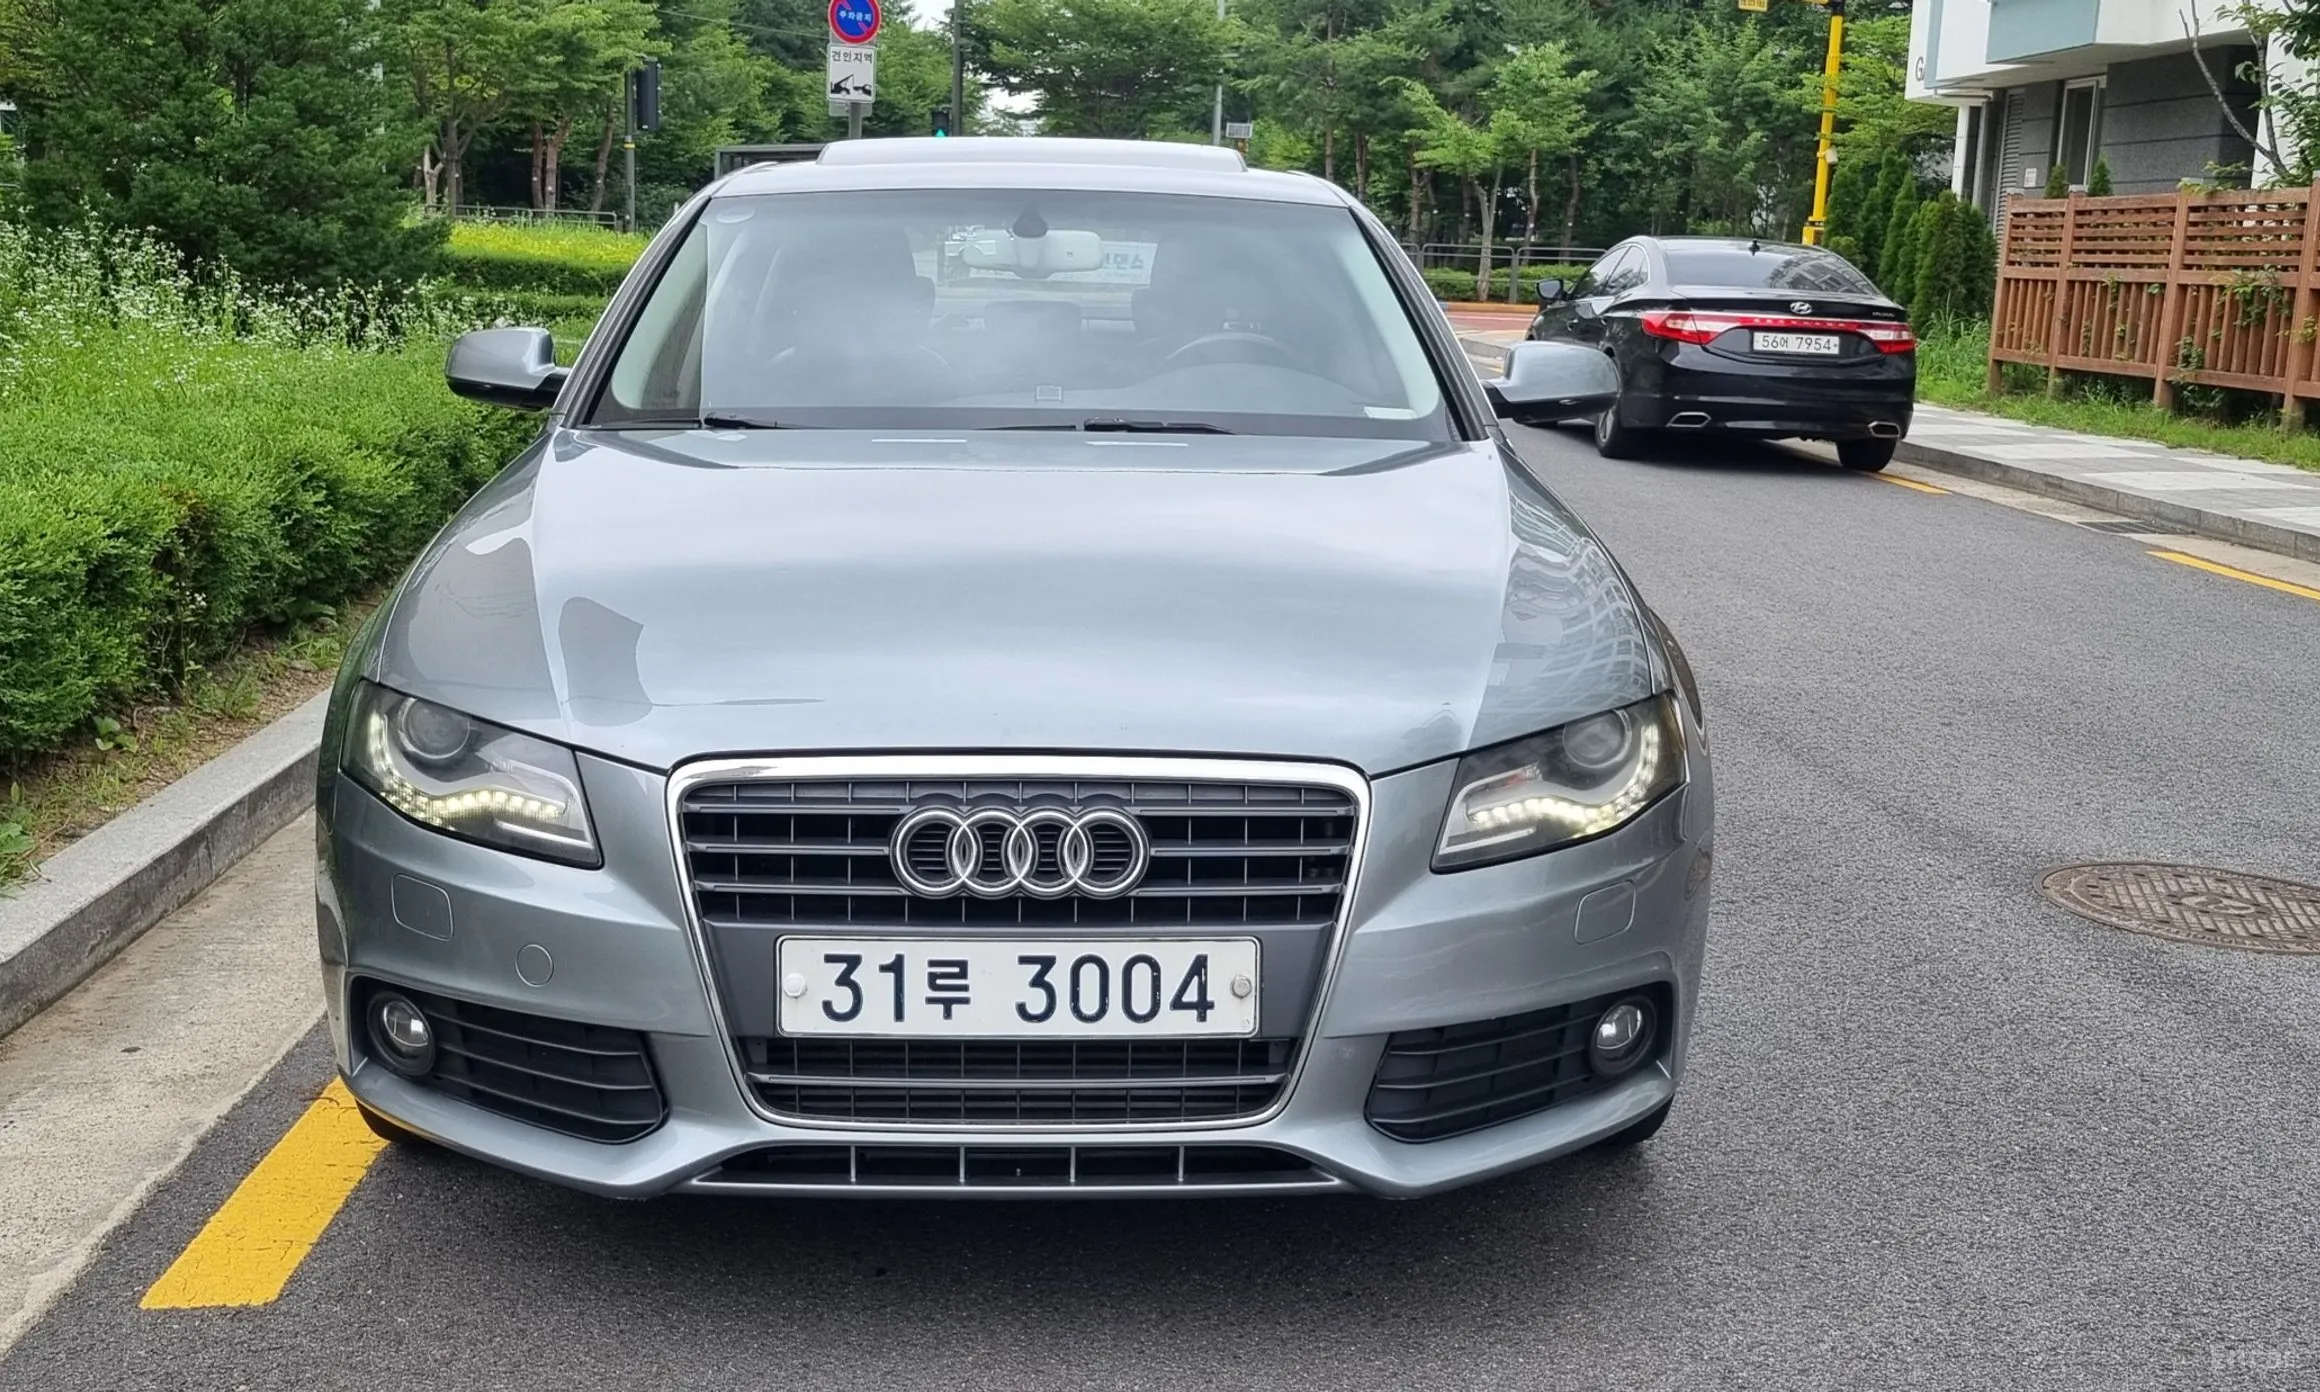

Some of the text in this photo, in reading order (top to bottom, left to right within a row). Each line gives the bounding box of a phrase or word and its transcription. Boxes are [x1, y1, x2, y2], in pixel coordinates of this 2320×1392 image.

[839, 10, 872, 22] 주차금지
[831, 50, 873, 64] 견인지역
[1795, 336, 1831, 351] 7954
[821, 953, 1215, 1023] 31루 3004
